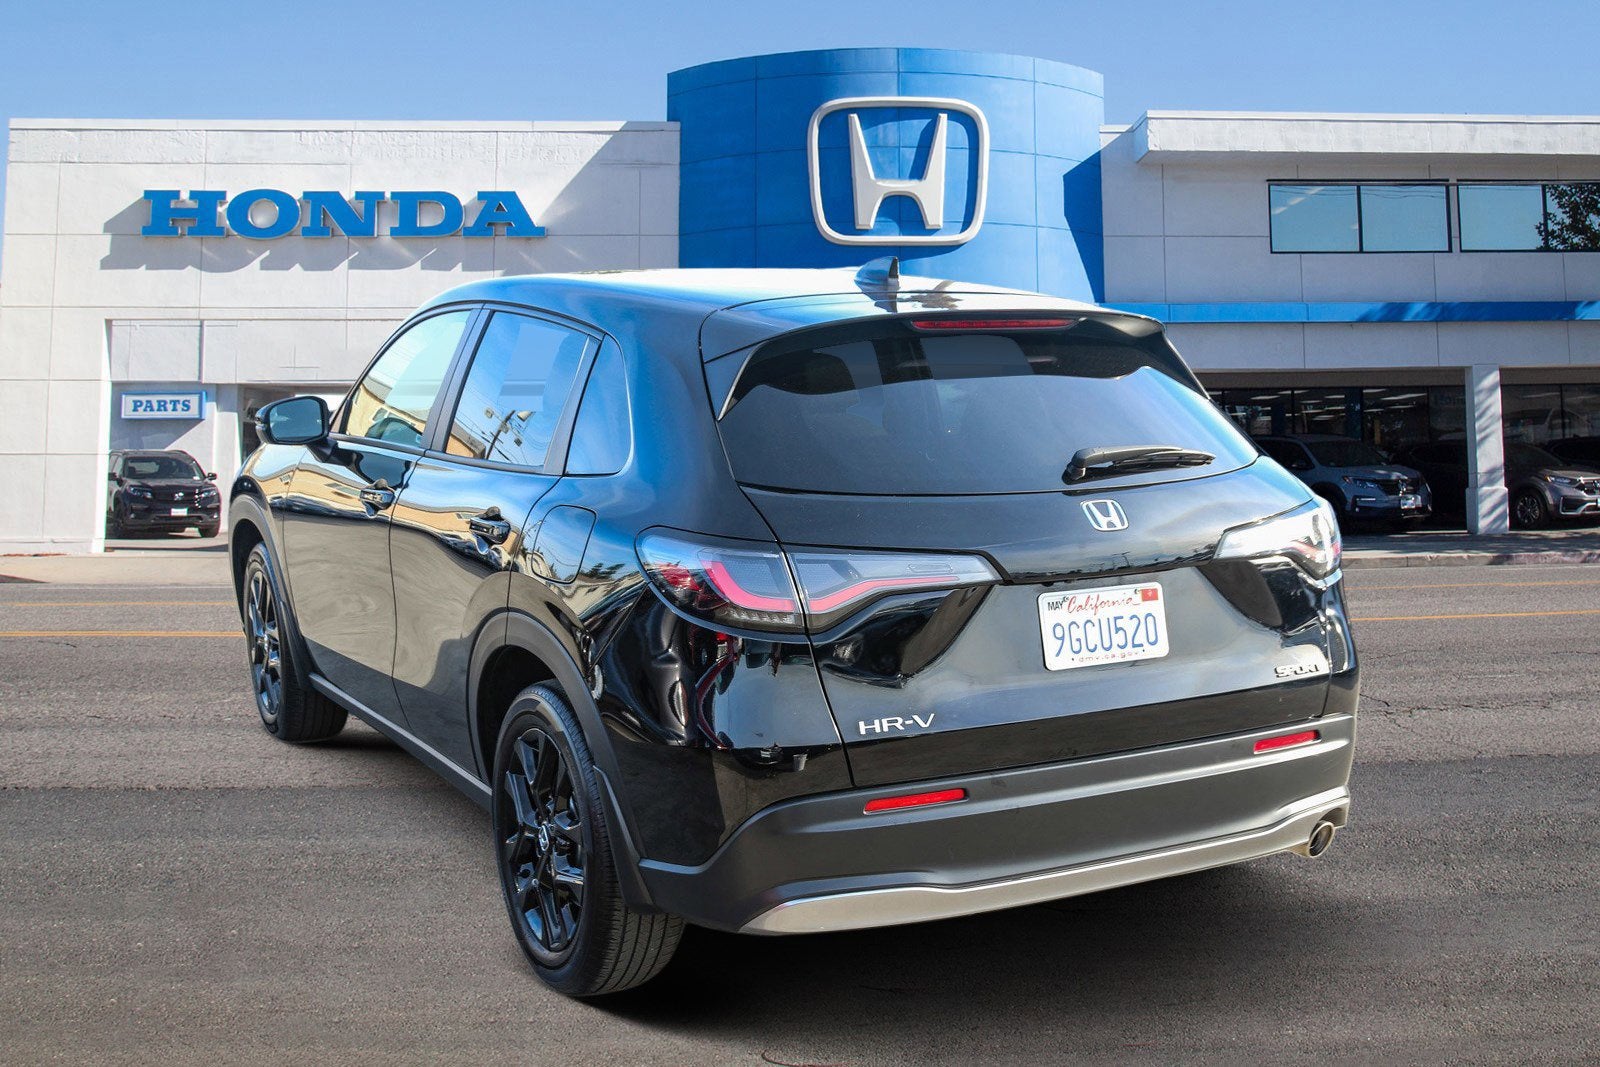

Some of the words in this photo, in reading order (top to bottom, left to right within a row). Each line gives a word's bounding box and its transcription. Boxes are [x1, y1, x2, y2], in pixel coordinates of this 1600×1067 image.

[141, 188, 548, 239] HONDA
[132, 399, 191, 412] PARTS
[1047, 600, 1064, 611] MAY
[1067, 593, 1141, 615] California
[1052, 612, 1159, 657] 9GCU520
[858, 713, 935, 735] HR-V
